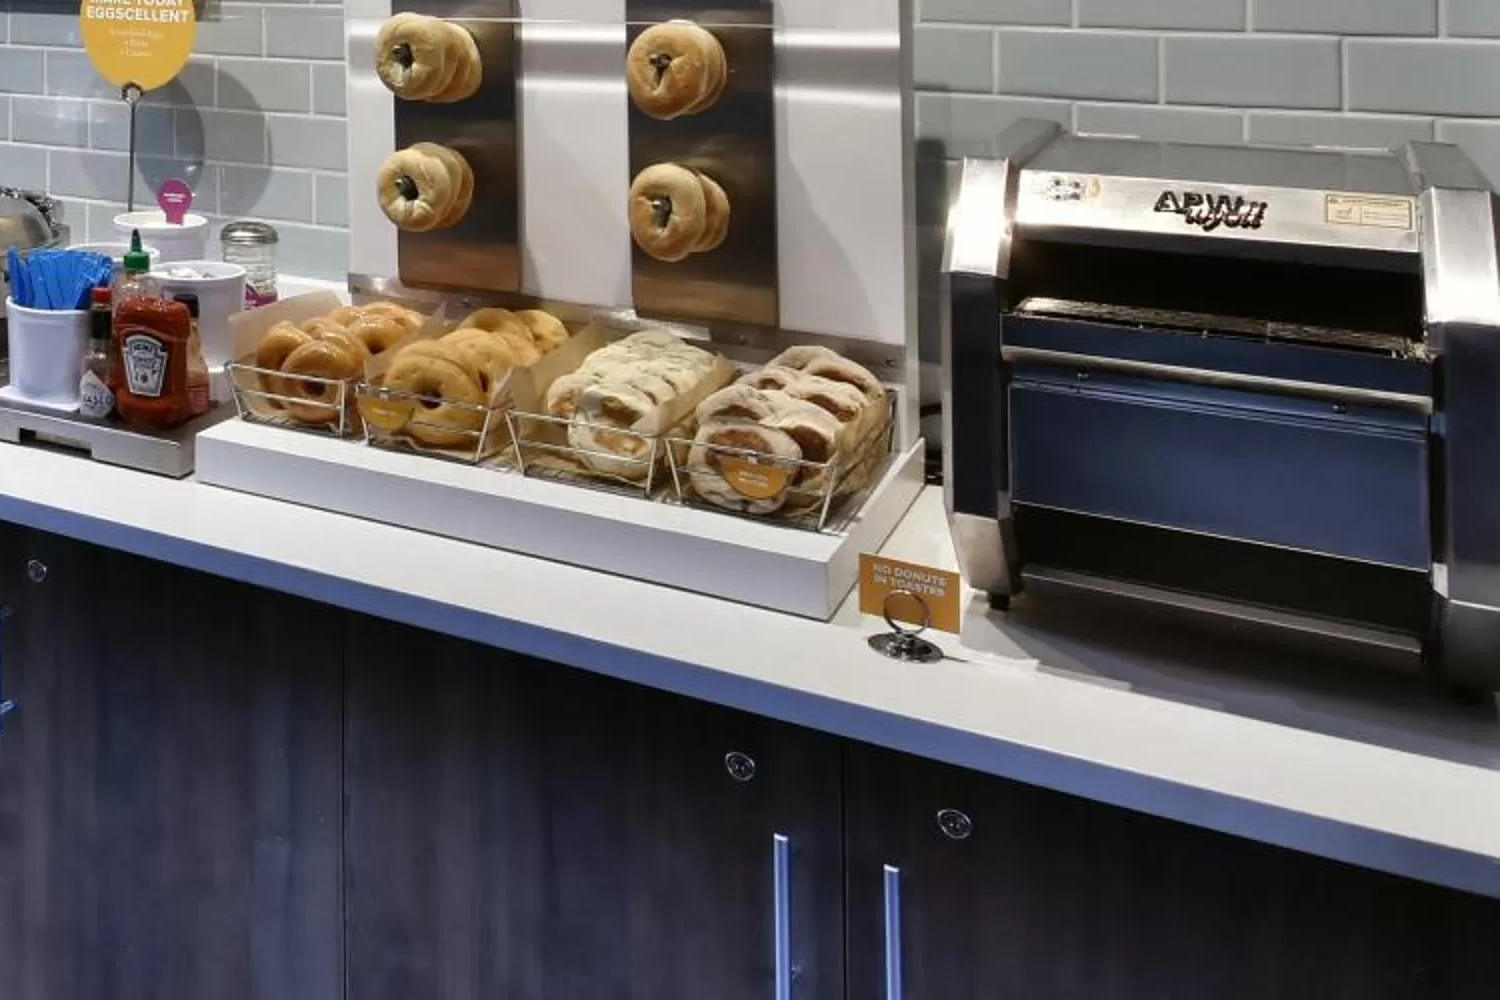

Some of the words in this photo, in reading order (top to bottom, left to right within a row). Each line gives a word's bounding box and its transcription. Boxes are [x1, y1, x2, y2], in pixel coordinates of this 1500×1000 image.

[86, 6, 189, 24] EGGSCELLENT
[1153, 190, 1245, 214] APW
[874, 563, 892, 575] NO
[894, 566, 948, 587] DONUTS
[890, 576, 946, 597] TOASTER
